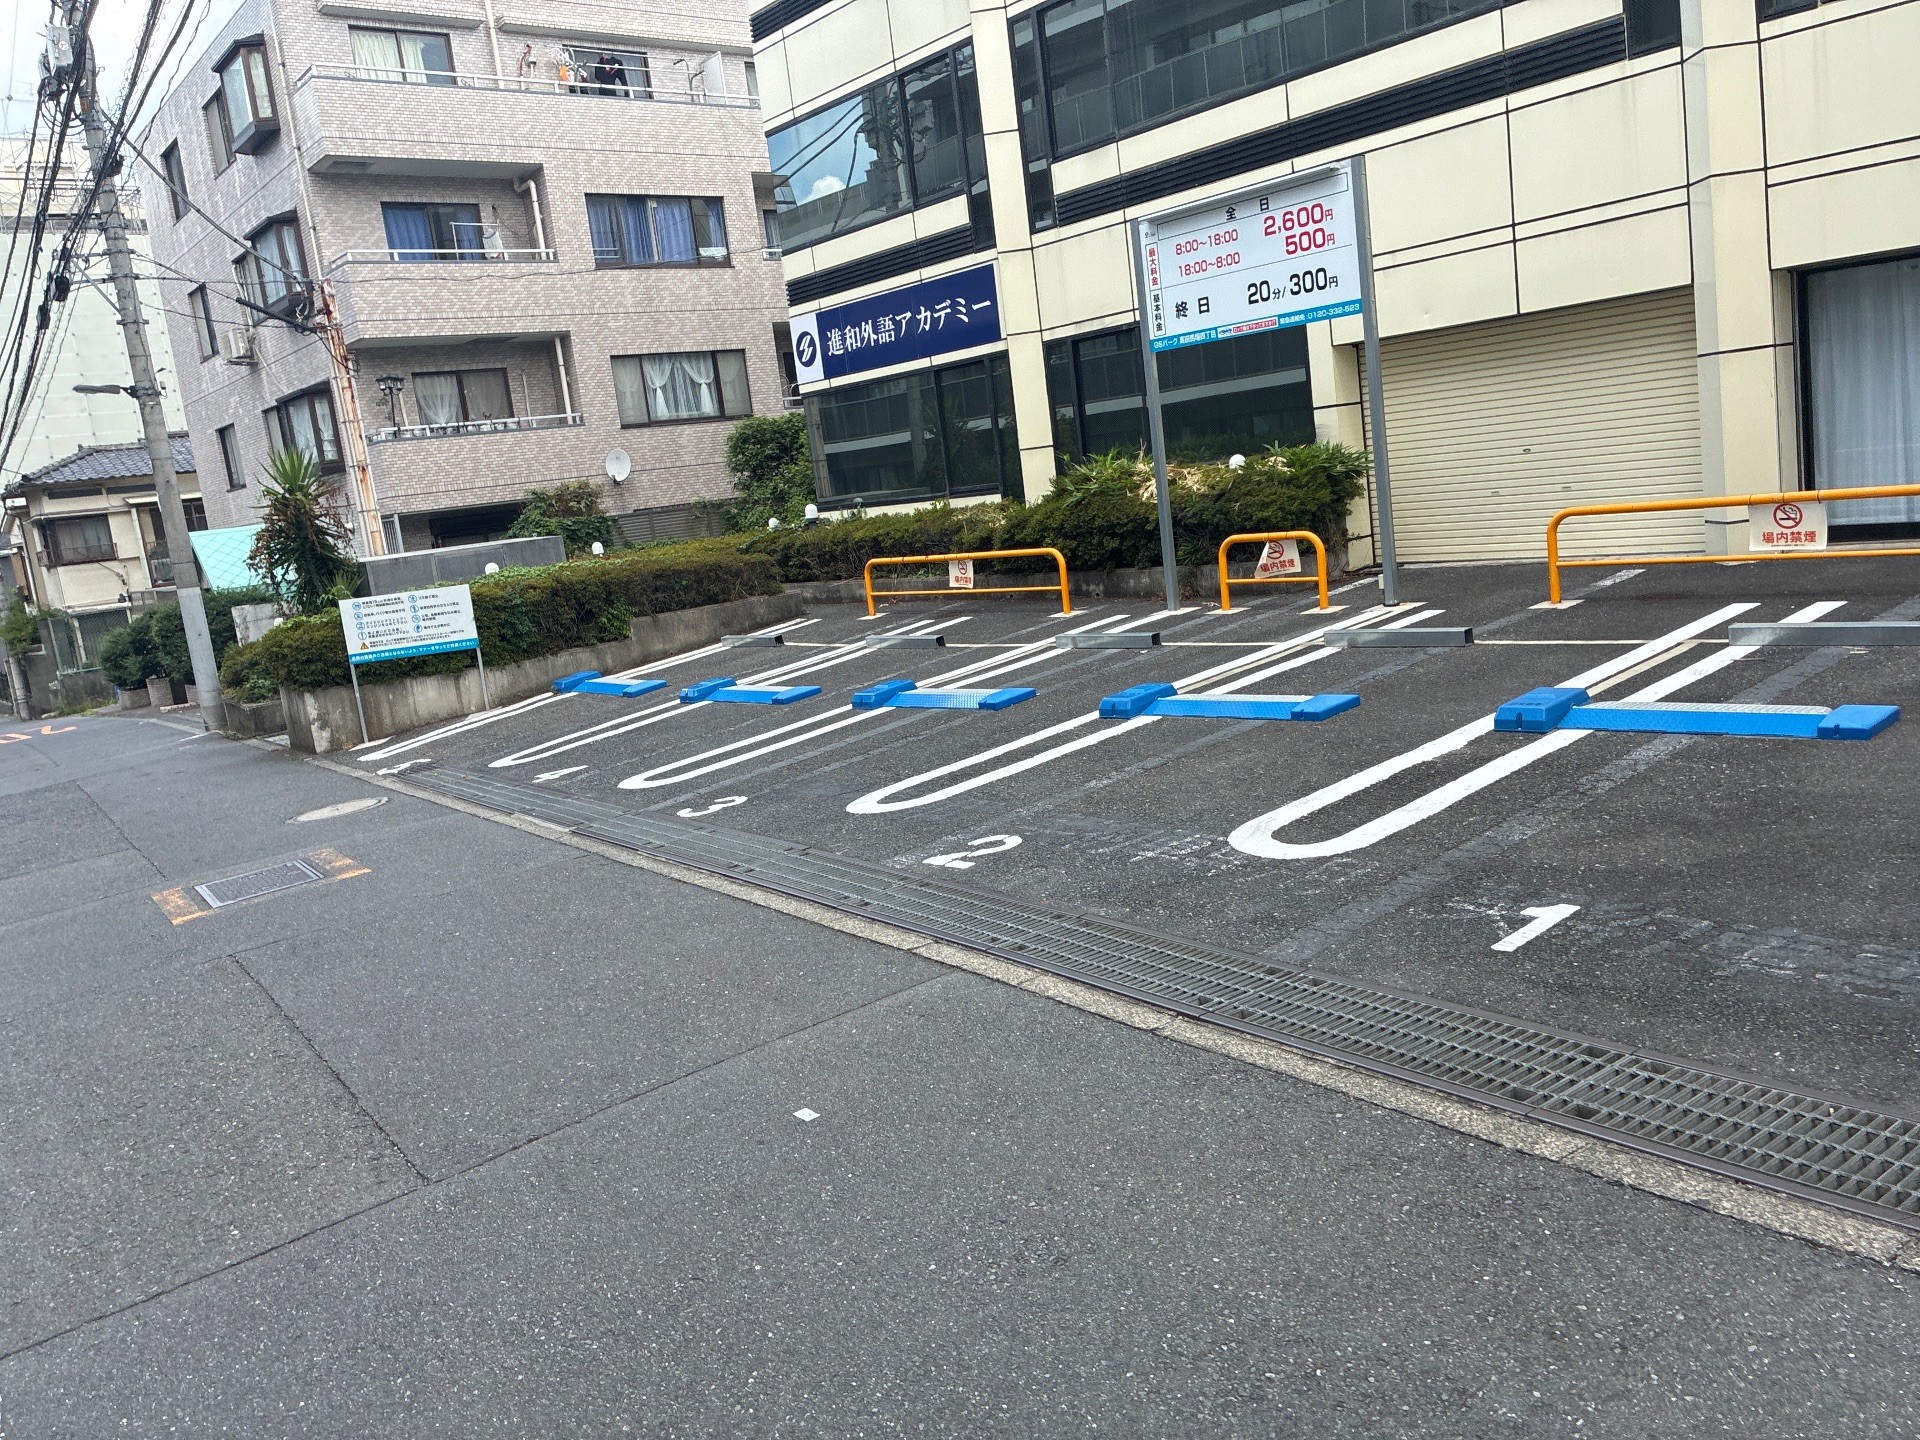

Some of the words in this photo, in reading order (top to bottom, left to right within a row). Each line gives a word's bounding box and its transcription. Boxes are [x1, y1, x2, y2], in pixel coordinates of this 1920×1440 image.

[1263, 203, 1334, 237] 2,600円
[1285, 227, 1336, 256] 500円
[1148, 247, 1159, 286] 最大料金
[1153, 294, 1163, 332] 基本料金
[1174, 296, 1211, 320] 終日
[826, 297, 992, 356] 進和外語アカデミー
[1761, 530, 1817, 544] 場内禁煙
[531, 765, 589, 783] 4
[676, 795, 749, 818] 3
[922, 834, 1023, 869] 2
[1490, 903, 1581, 952] 1
